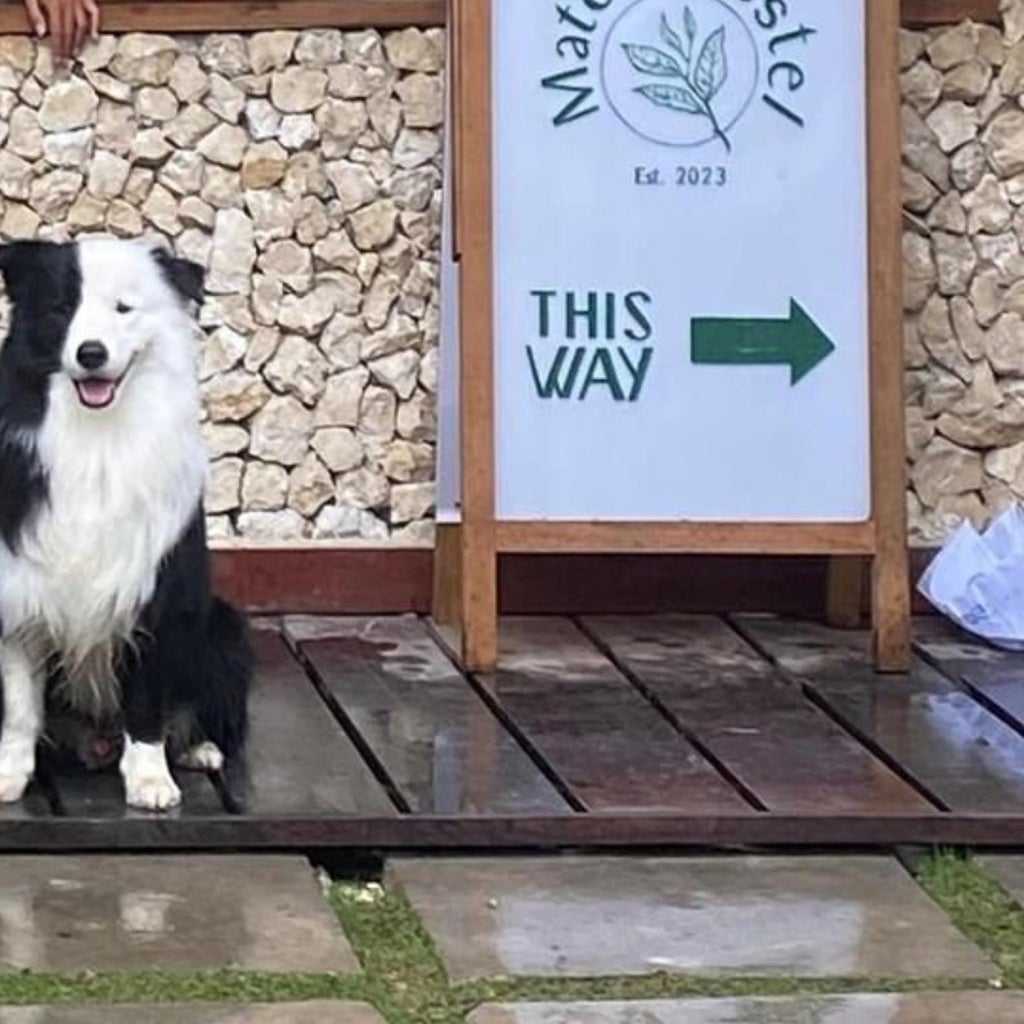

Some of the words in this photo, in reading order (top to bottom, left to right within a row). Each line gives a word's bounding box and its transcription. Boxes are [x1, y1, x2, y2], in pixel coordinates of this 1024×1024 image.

[634, 166, 666, 186] Est.
[676, 166, 727, 187] 2023
[530, 290, 653, 342] THIS
[525, 345, 655, 403] WAY
